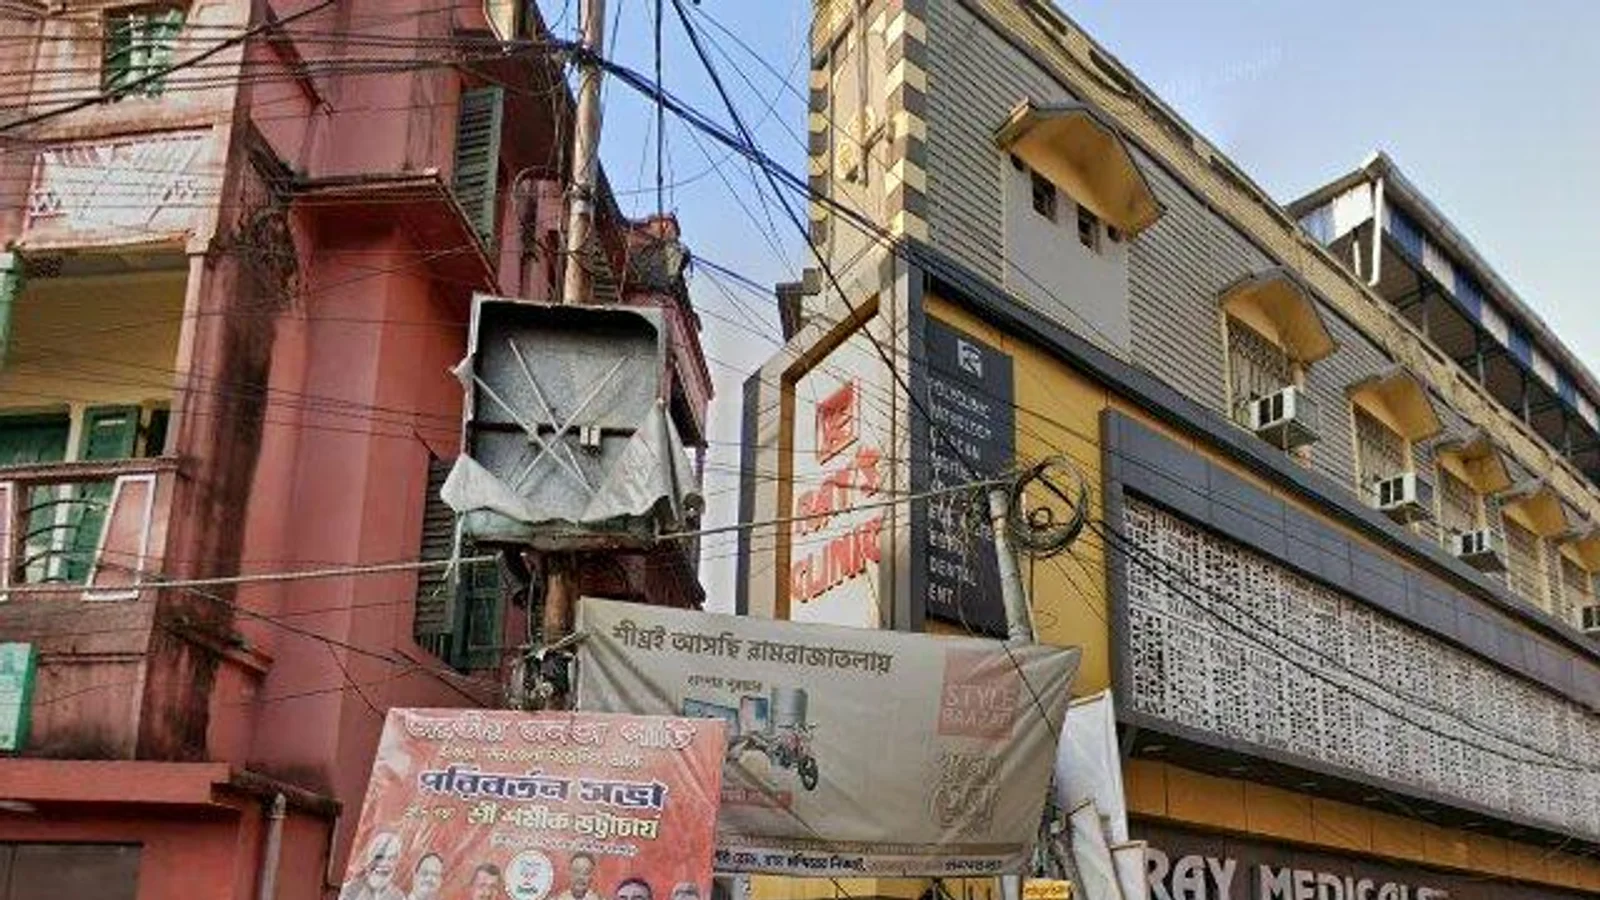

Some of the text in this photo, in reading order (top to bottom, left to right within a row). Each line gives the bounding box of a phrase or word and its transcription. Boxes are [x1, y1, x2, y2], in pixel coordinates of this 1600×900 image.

[791, 516, 881, 604] CLINIC
[671, 632, 743, 657] আসছি
[945, 681, 1014, 712] STYLE
[418, 762, 669, 809] পরিবর্তন সভা
[1143, 848, 1237, 900] RAY
